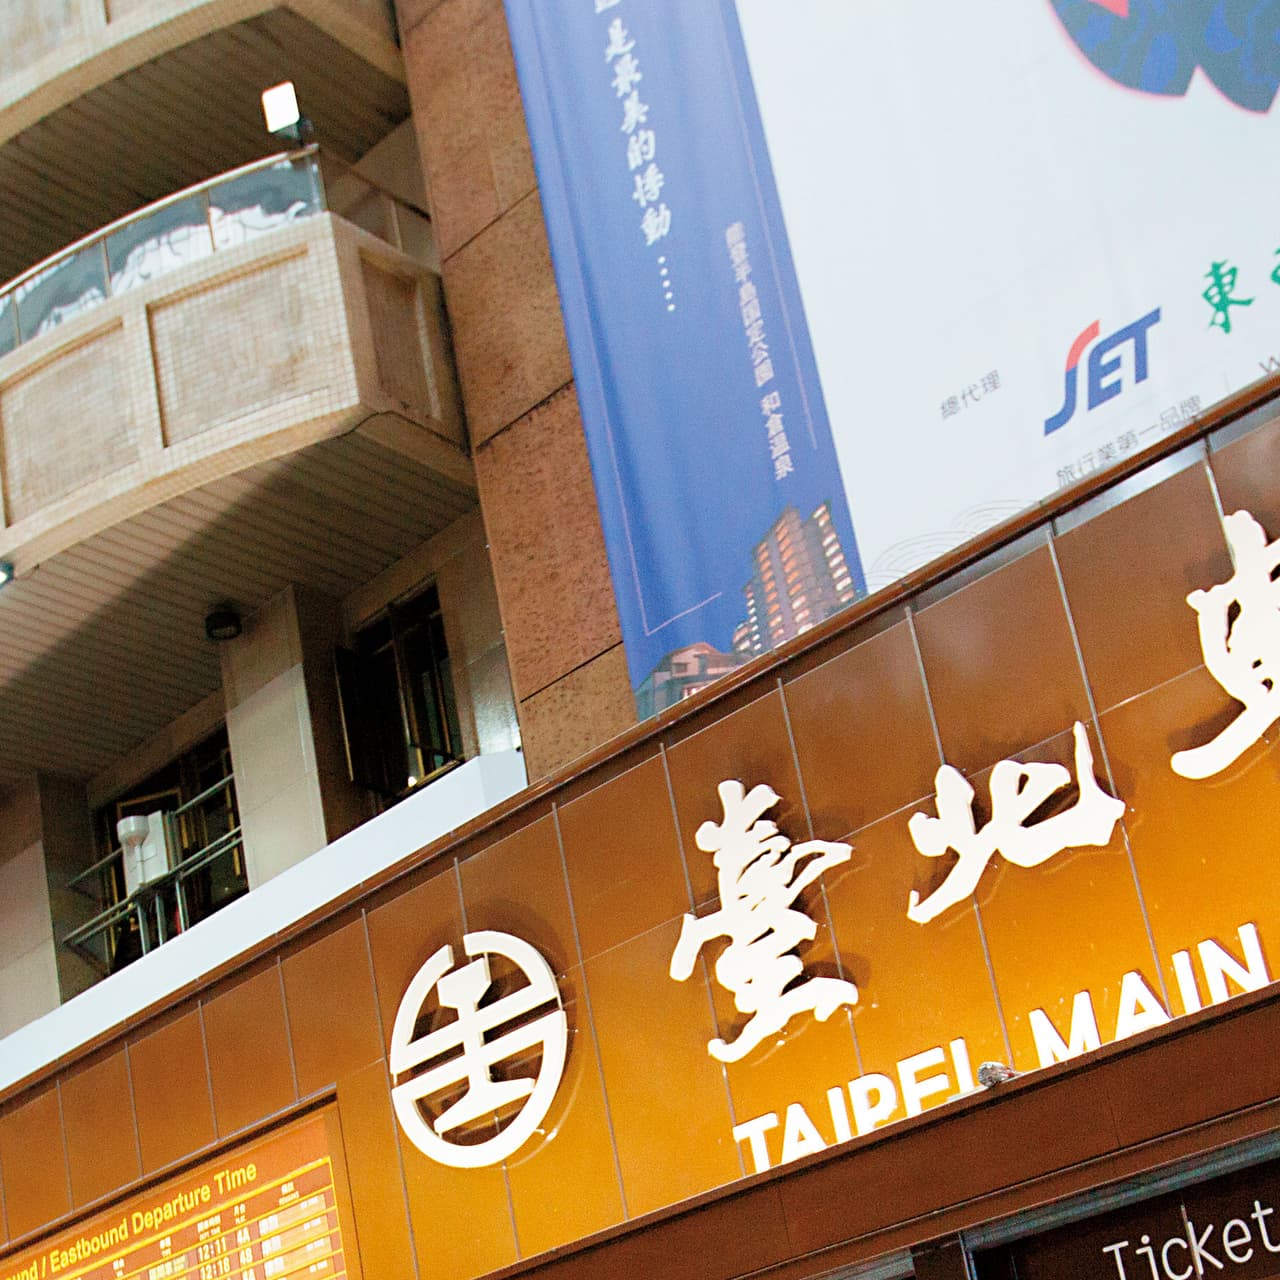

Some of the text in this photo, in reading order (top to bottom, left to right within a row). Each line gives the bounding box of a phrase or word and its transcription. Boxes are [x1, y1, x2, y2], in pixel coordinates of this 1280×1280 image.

[1043, 306, 1162, 436] JET
[732, 1036, 982, 1174] TAIPEI
[1027, 921, 1273, 1073] MAIN
[49, 1217, 129, 1273] Eastbound
[131, 1184, 212, 1236] Departure
[213, 1163, 258, 1196] Time
